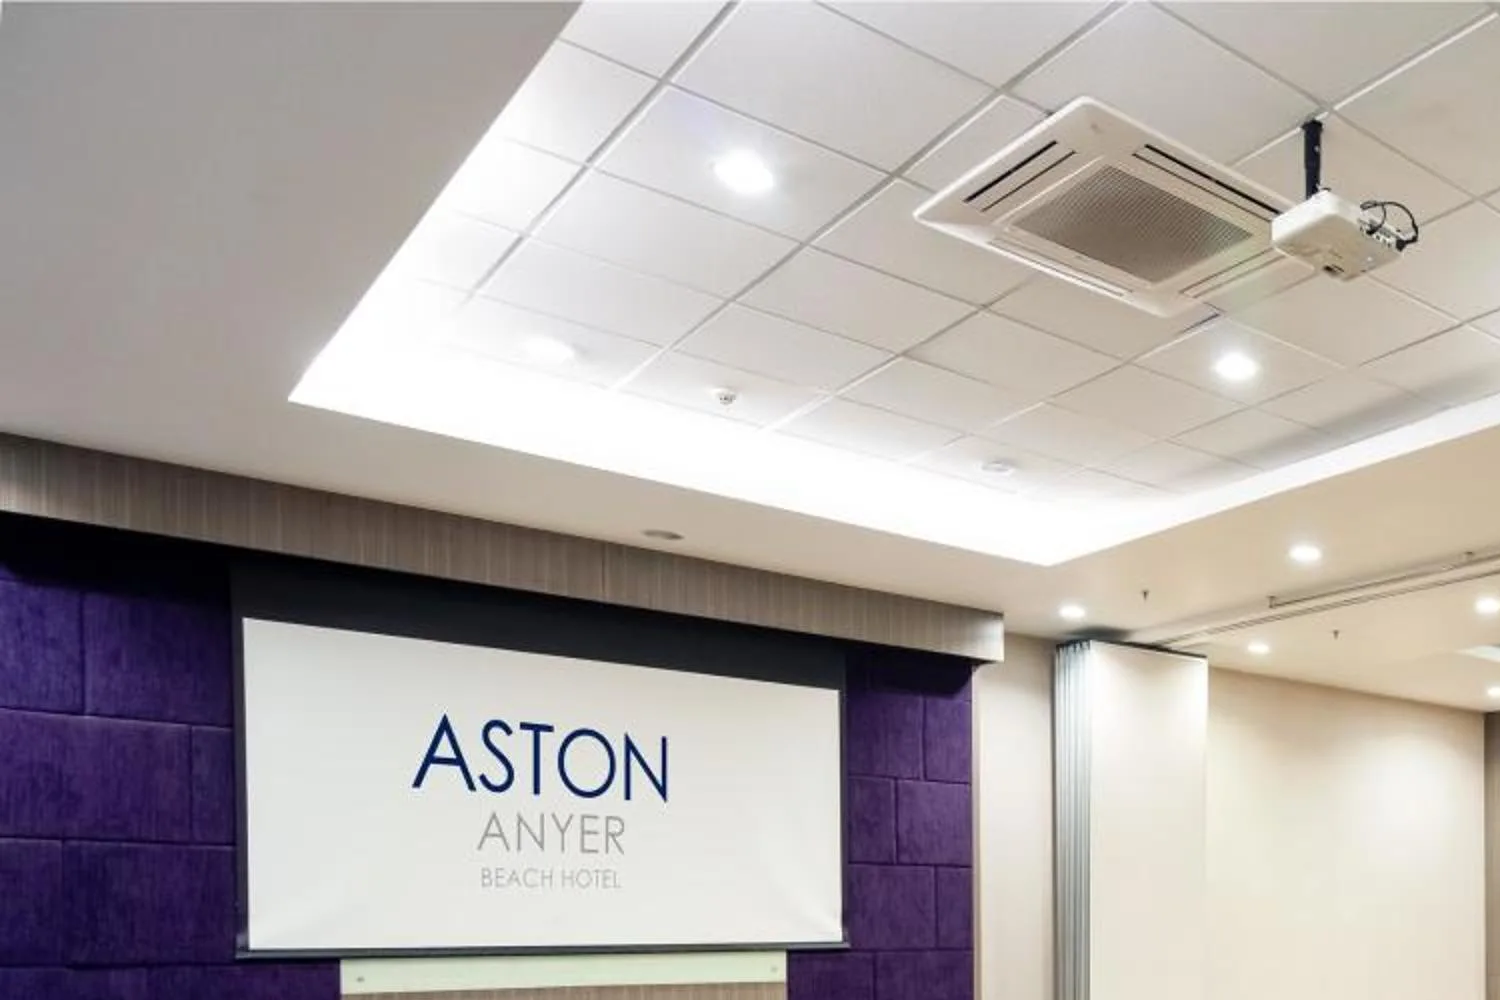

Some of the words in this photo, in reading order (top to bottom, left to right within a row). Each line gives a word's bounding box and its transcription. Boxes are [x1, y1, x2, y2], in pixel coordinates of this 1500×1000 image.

[412, 713, 668, 803] ASTON
[477, 811, 625, 854] ANYER
[481, 867, 553, 889] BEACH
[561, 868, 621, 889] HOTEL
